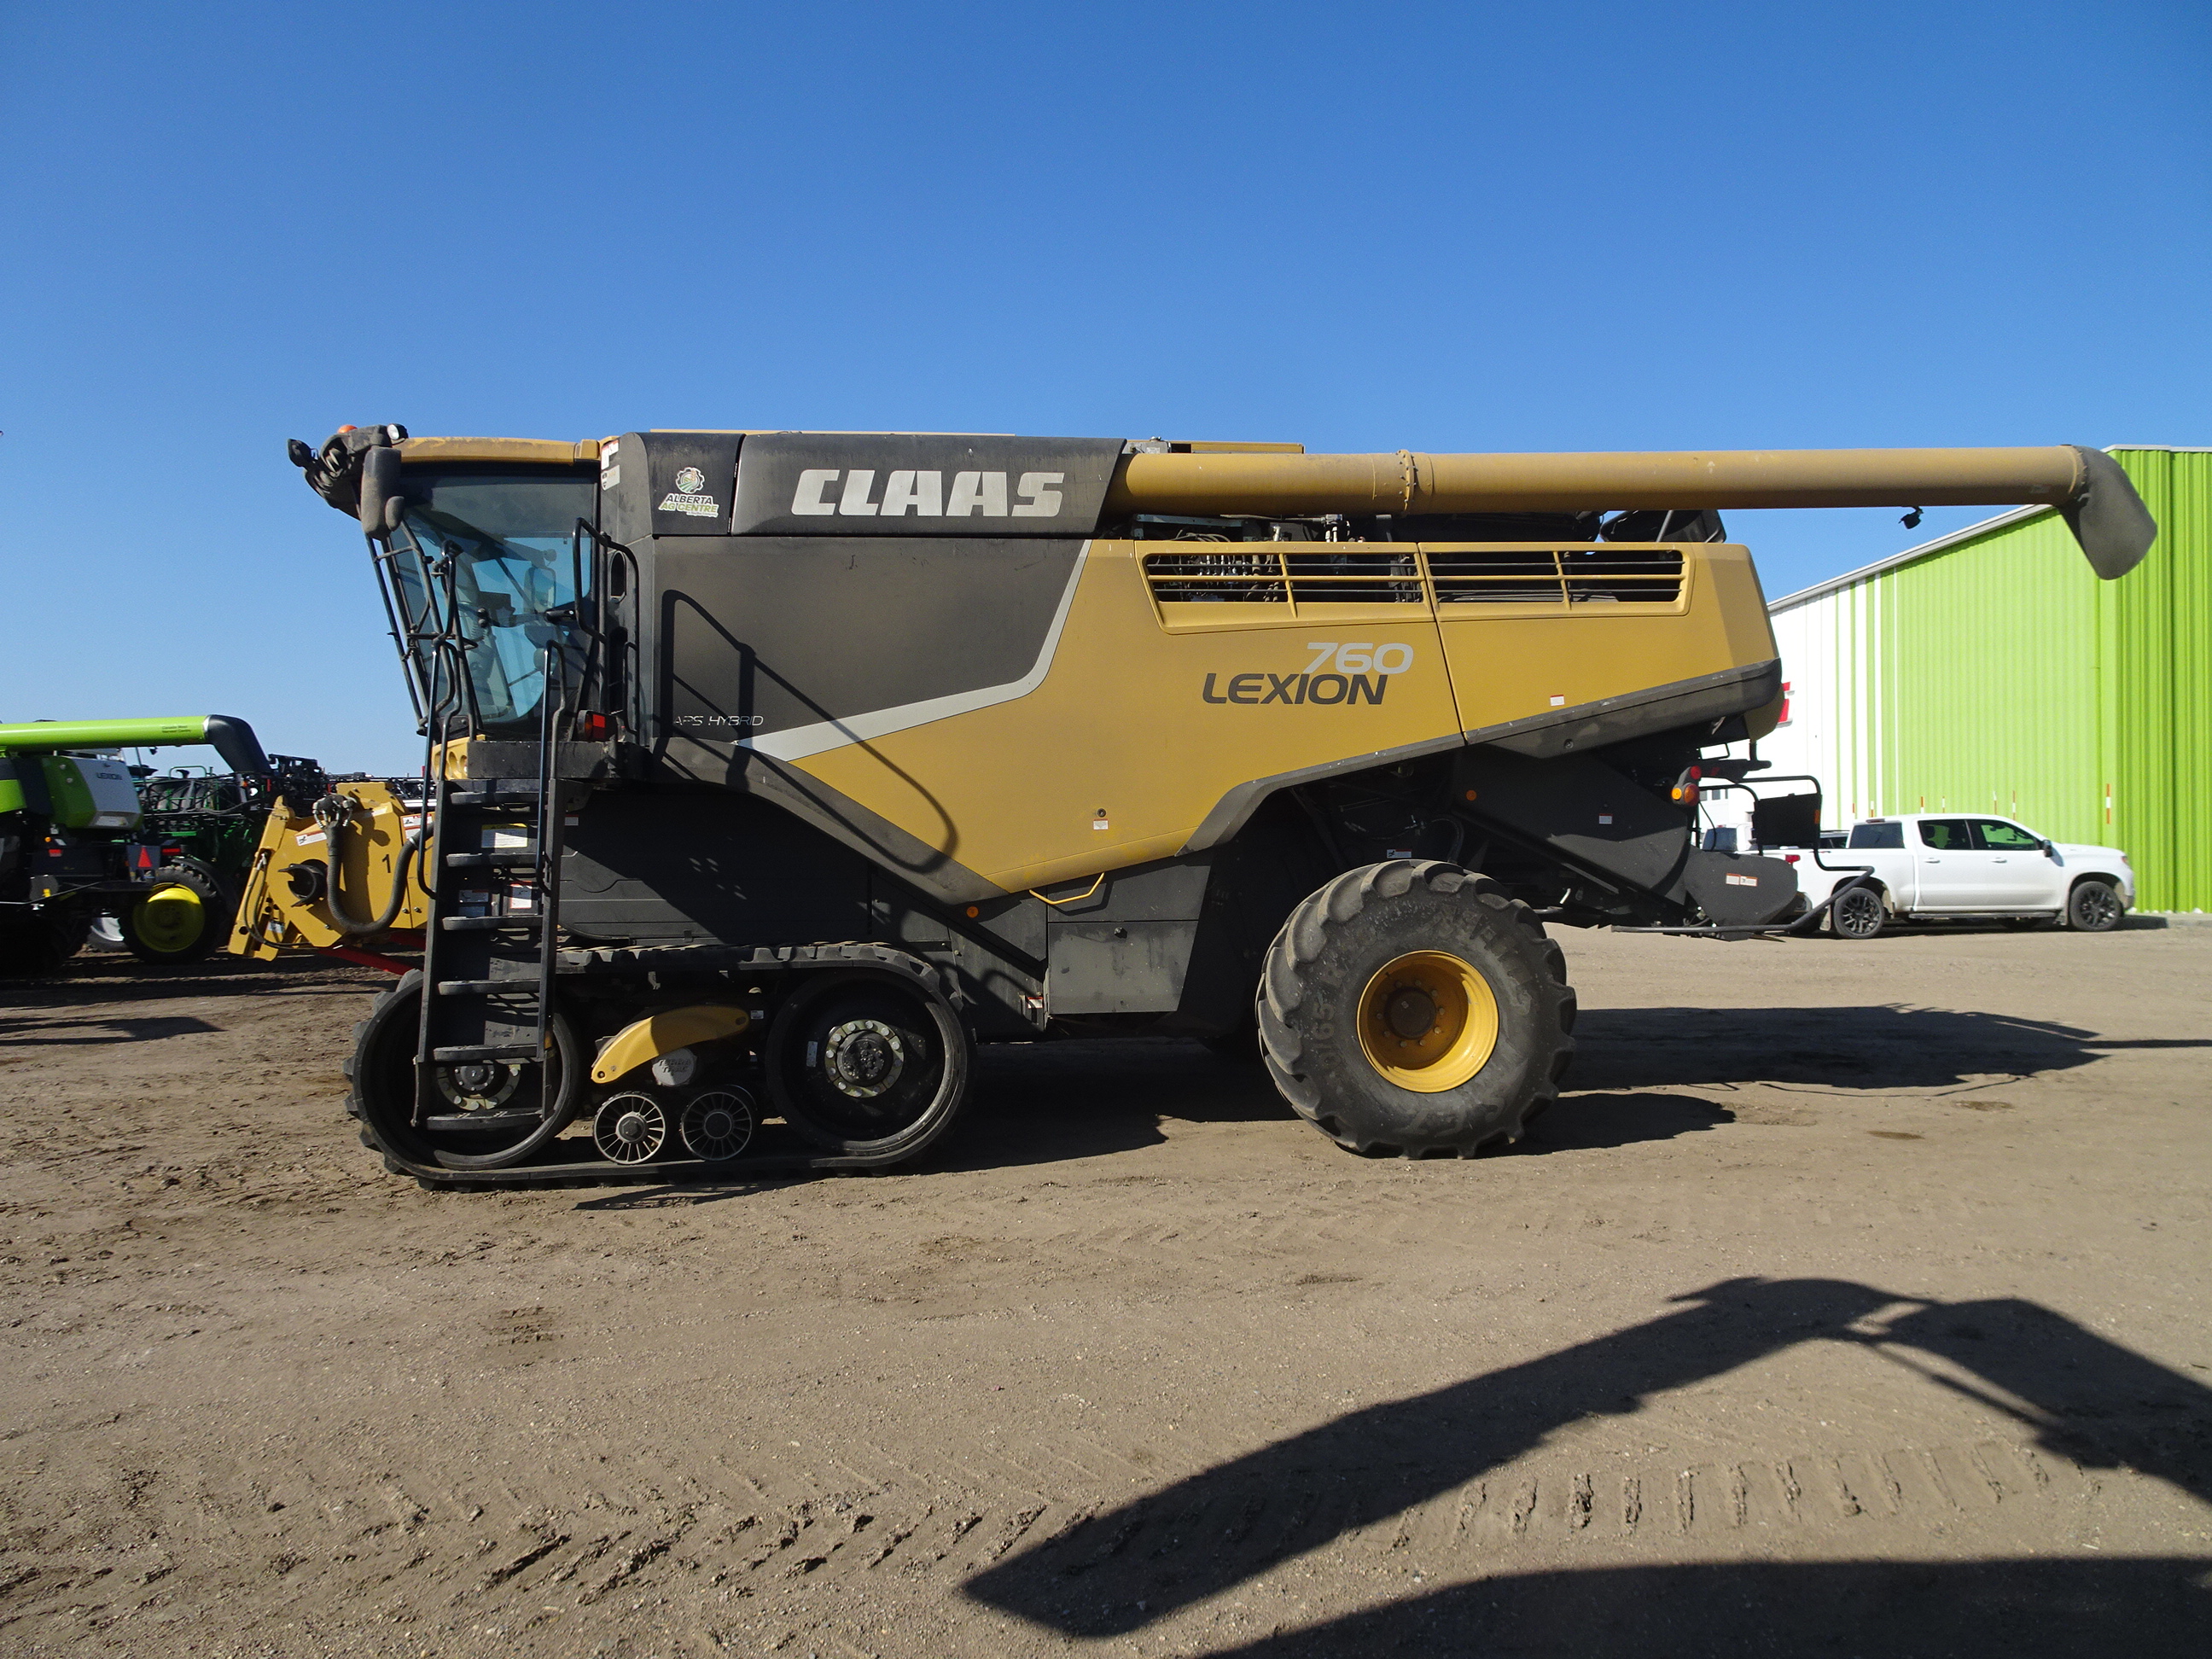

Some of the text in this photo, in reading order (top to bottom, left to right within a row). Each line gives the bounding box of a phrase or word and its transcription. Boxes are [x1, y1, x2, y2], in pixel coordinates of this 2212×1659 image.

[666, 494, 712, 504] ALBERTA
[791, 469, 1065, 517] CLAAS
[661, 502, 718, 513] AG CENTRE
[1302, 642, 1414, 674] 760
[1202, 672, 1388, 705] LEXION
[707, 715, 764, 726] HYBRID
[381, 853, 392, 874] 1
